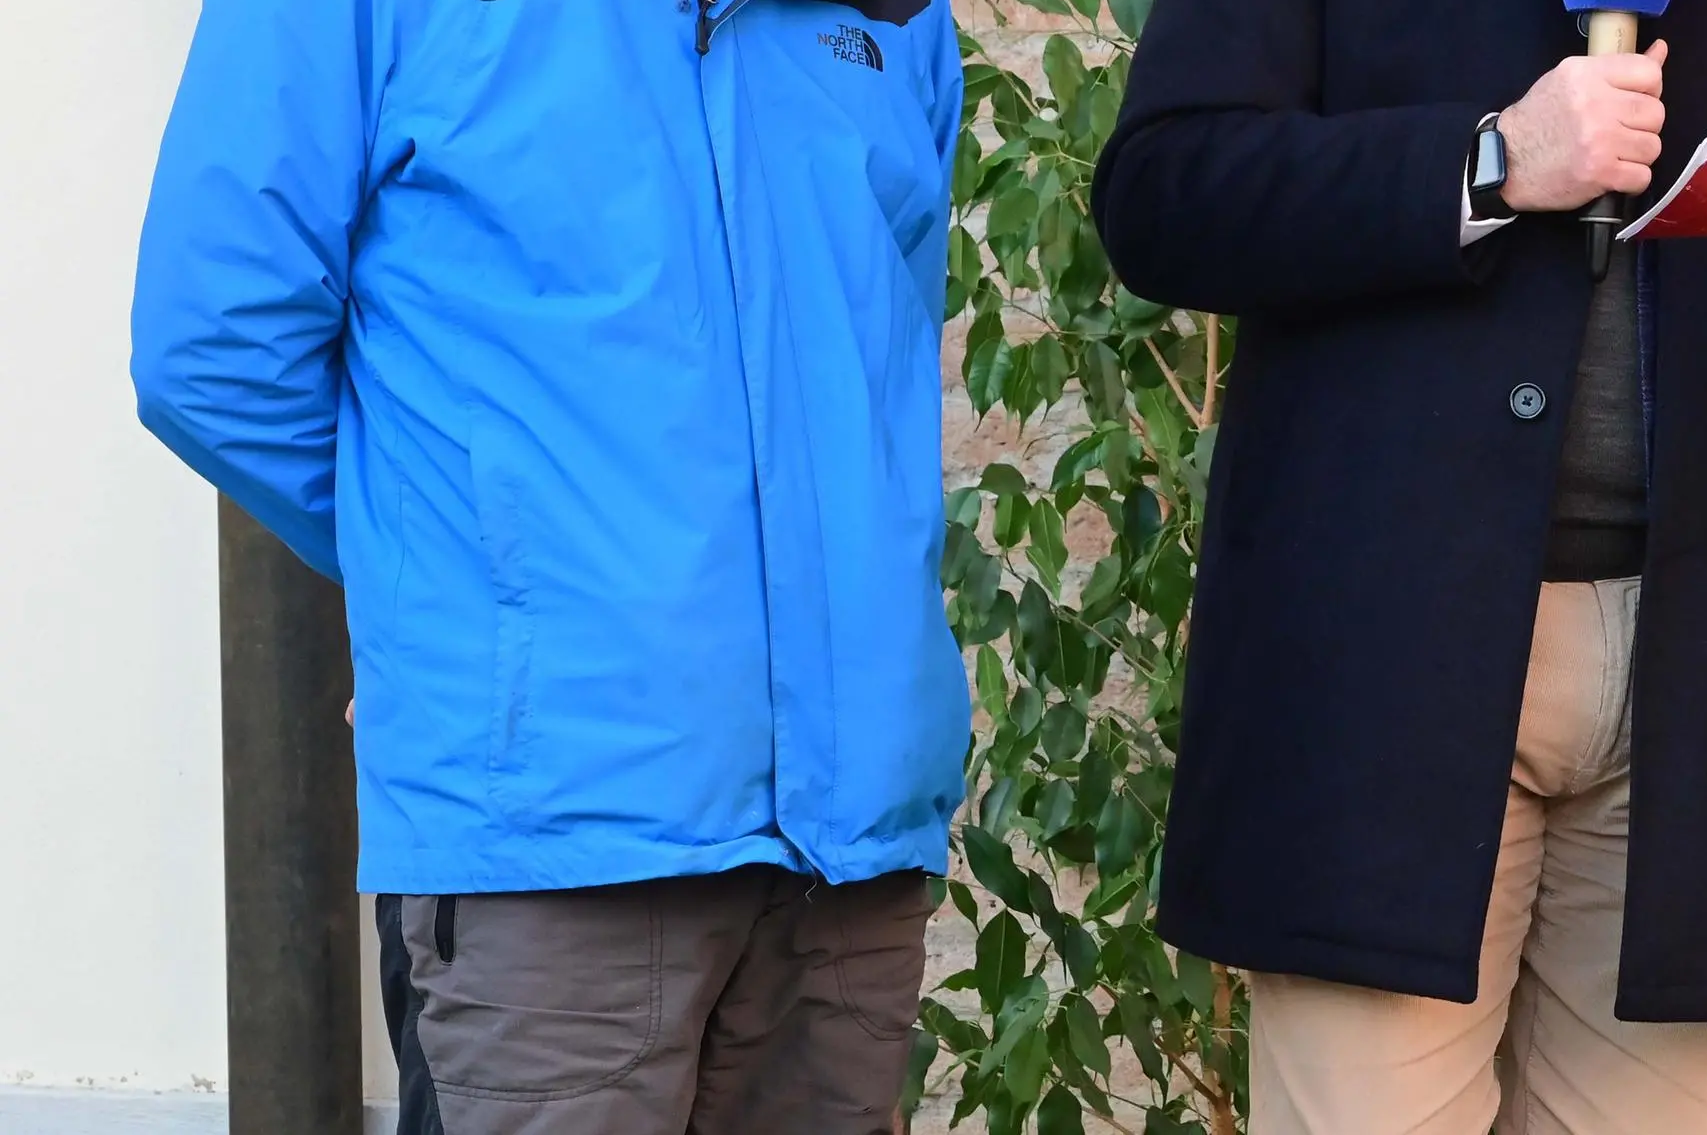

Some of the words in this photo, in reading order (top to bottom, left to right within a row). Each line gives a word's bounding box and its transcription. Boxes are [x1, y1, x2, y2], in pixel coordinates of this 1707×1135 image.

[837, 24, 863, 40] THE
[817, 33, 864, 52] NORTH
[833, 48, 866, 65] FACE
